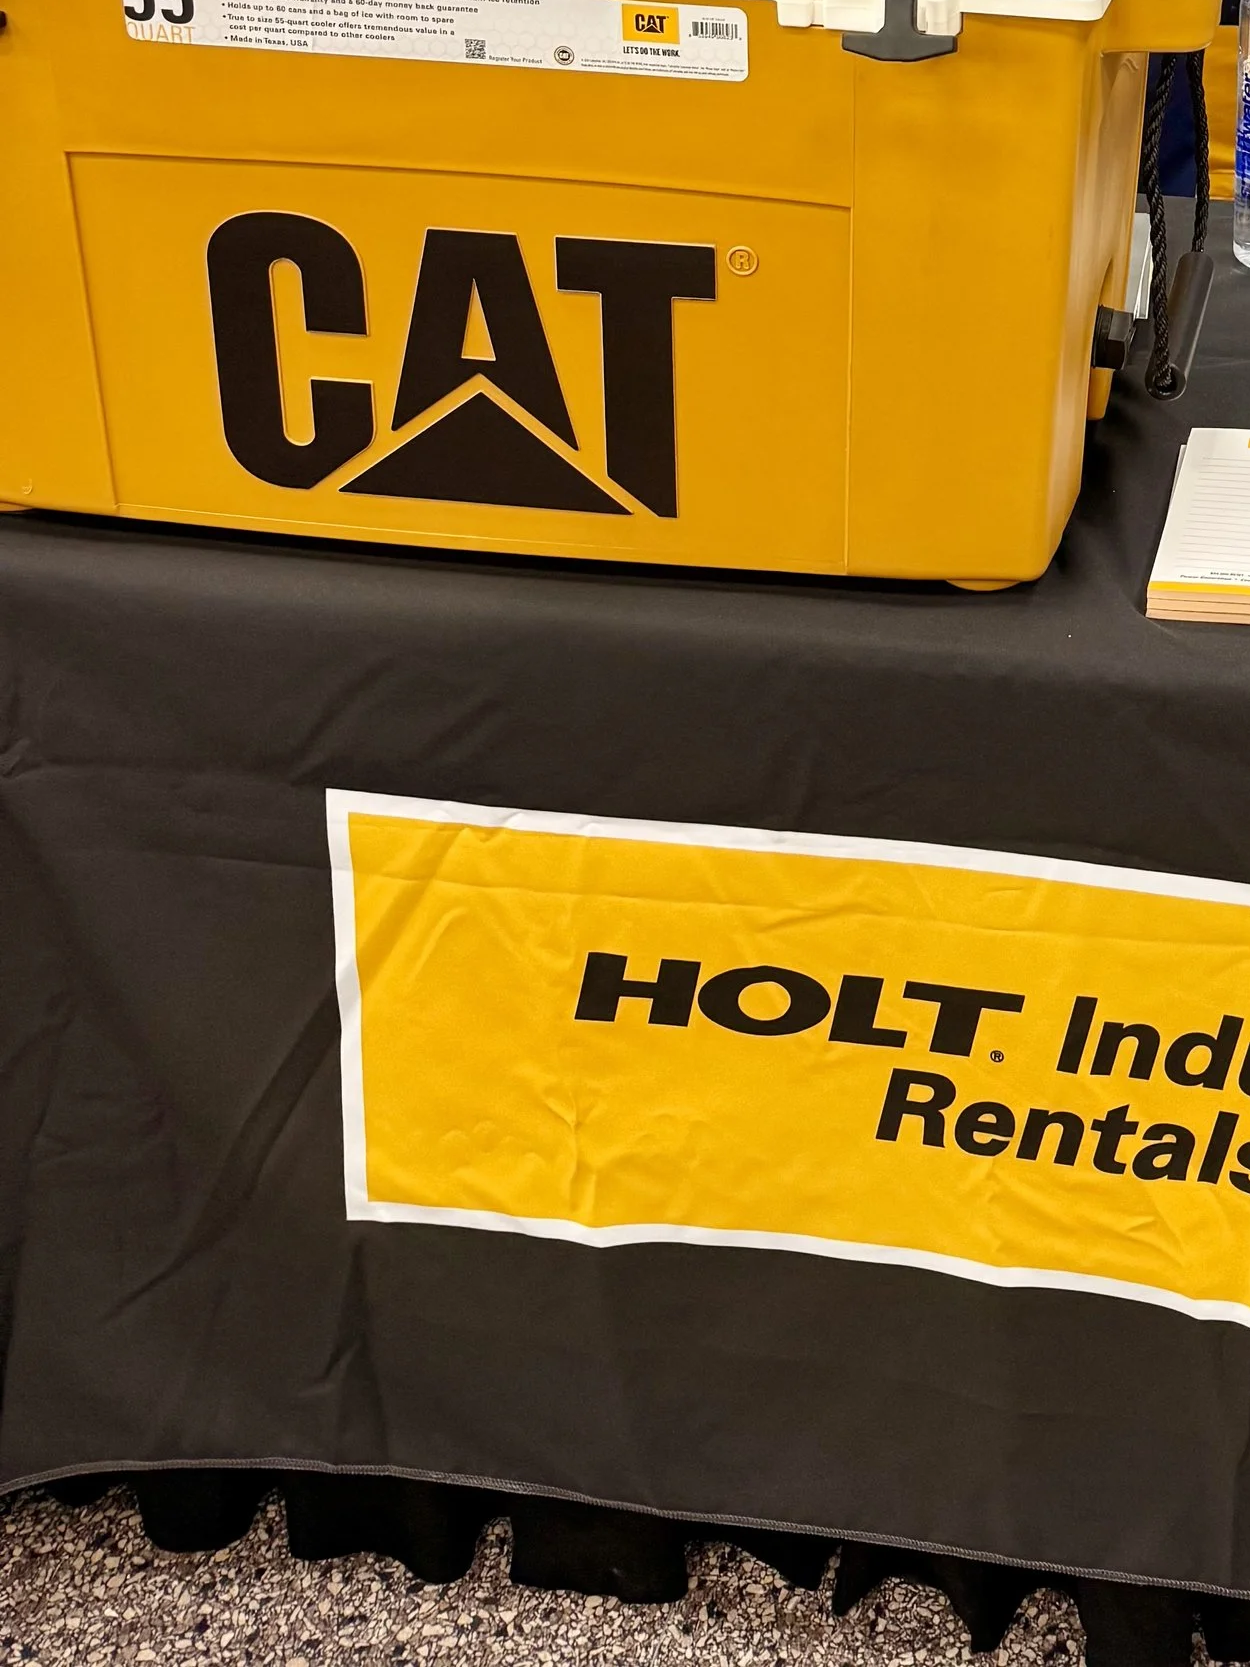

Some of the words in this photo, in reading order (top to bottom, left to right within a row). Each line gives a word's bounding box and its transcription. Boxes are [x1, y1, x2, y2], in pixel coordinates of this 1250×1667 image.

[227, 2, 251, 11] Holds
[253, 4, 264, 13] up
[288, 7, 307, 15] cans
[309, 7, 324, 16] and
[333, 9, 349, 19] bag
[351, 10, 359, 18] of
[361, 11, 374, 19] ice
[376, 11, 395, 21] with
[396, 14, 419, 22] room
[420, 15, 430, 23] to
[431, 16, 455, 25] spare
[385, 1, 413, 11] money
[415, 2, 435, 11] back
[437, 4, 479, 14] guarantee
[227, 13, 245, 23] True
[246, 15, 256, 23] to
[257, 16, 273, 24] size
[274, 16, 309, 28] 55-quart
[310, 19, 337, 29] cooler
[338, 21, 362, 30] offers
[364, 22, 414, 34] tremendous
[415, 26, 438, 35] value
[439, 27, 448, 35] in
[229, 23, 247, 32] cost
[249, 25, 262, 34] per
[264, 25, 286, 35] quart
[287, 27, 328, 38] compared
[329, 30, 339, 38] to
[341, 30, 363, 39] other
[365, 32, 396, 41] coolers
[635, 13, 667, 34] CAT
[230, 34, 253, 44] Made
[254, 36, 263, 44] in
[290, 39, 309, 48] USA
[623, 45, 640, 55] LET'S
[639, 46, 649, 55] DO
[649, 47, 661, 56] THE
[206, 210, 718, 519] CAT
[572, 951, 1026, 1057] HOLT
